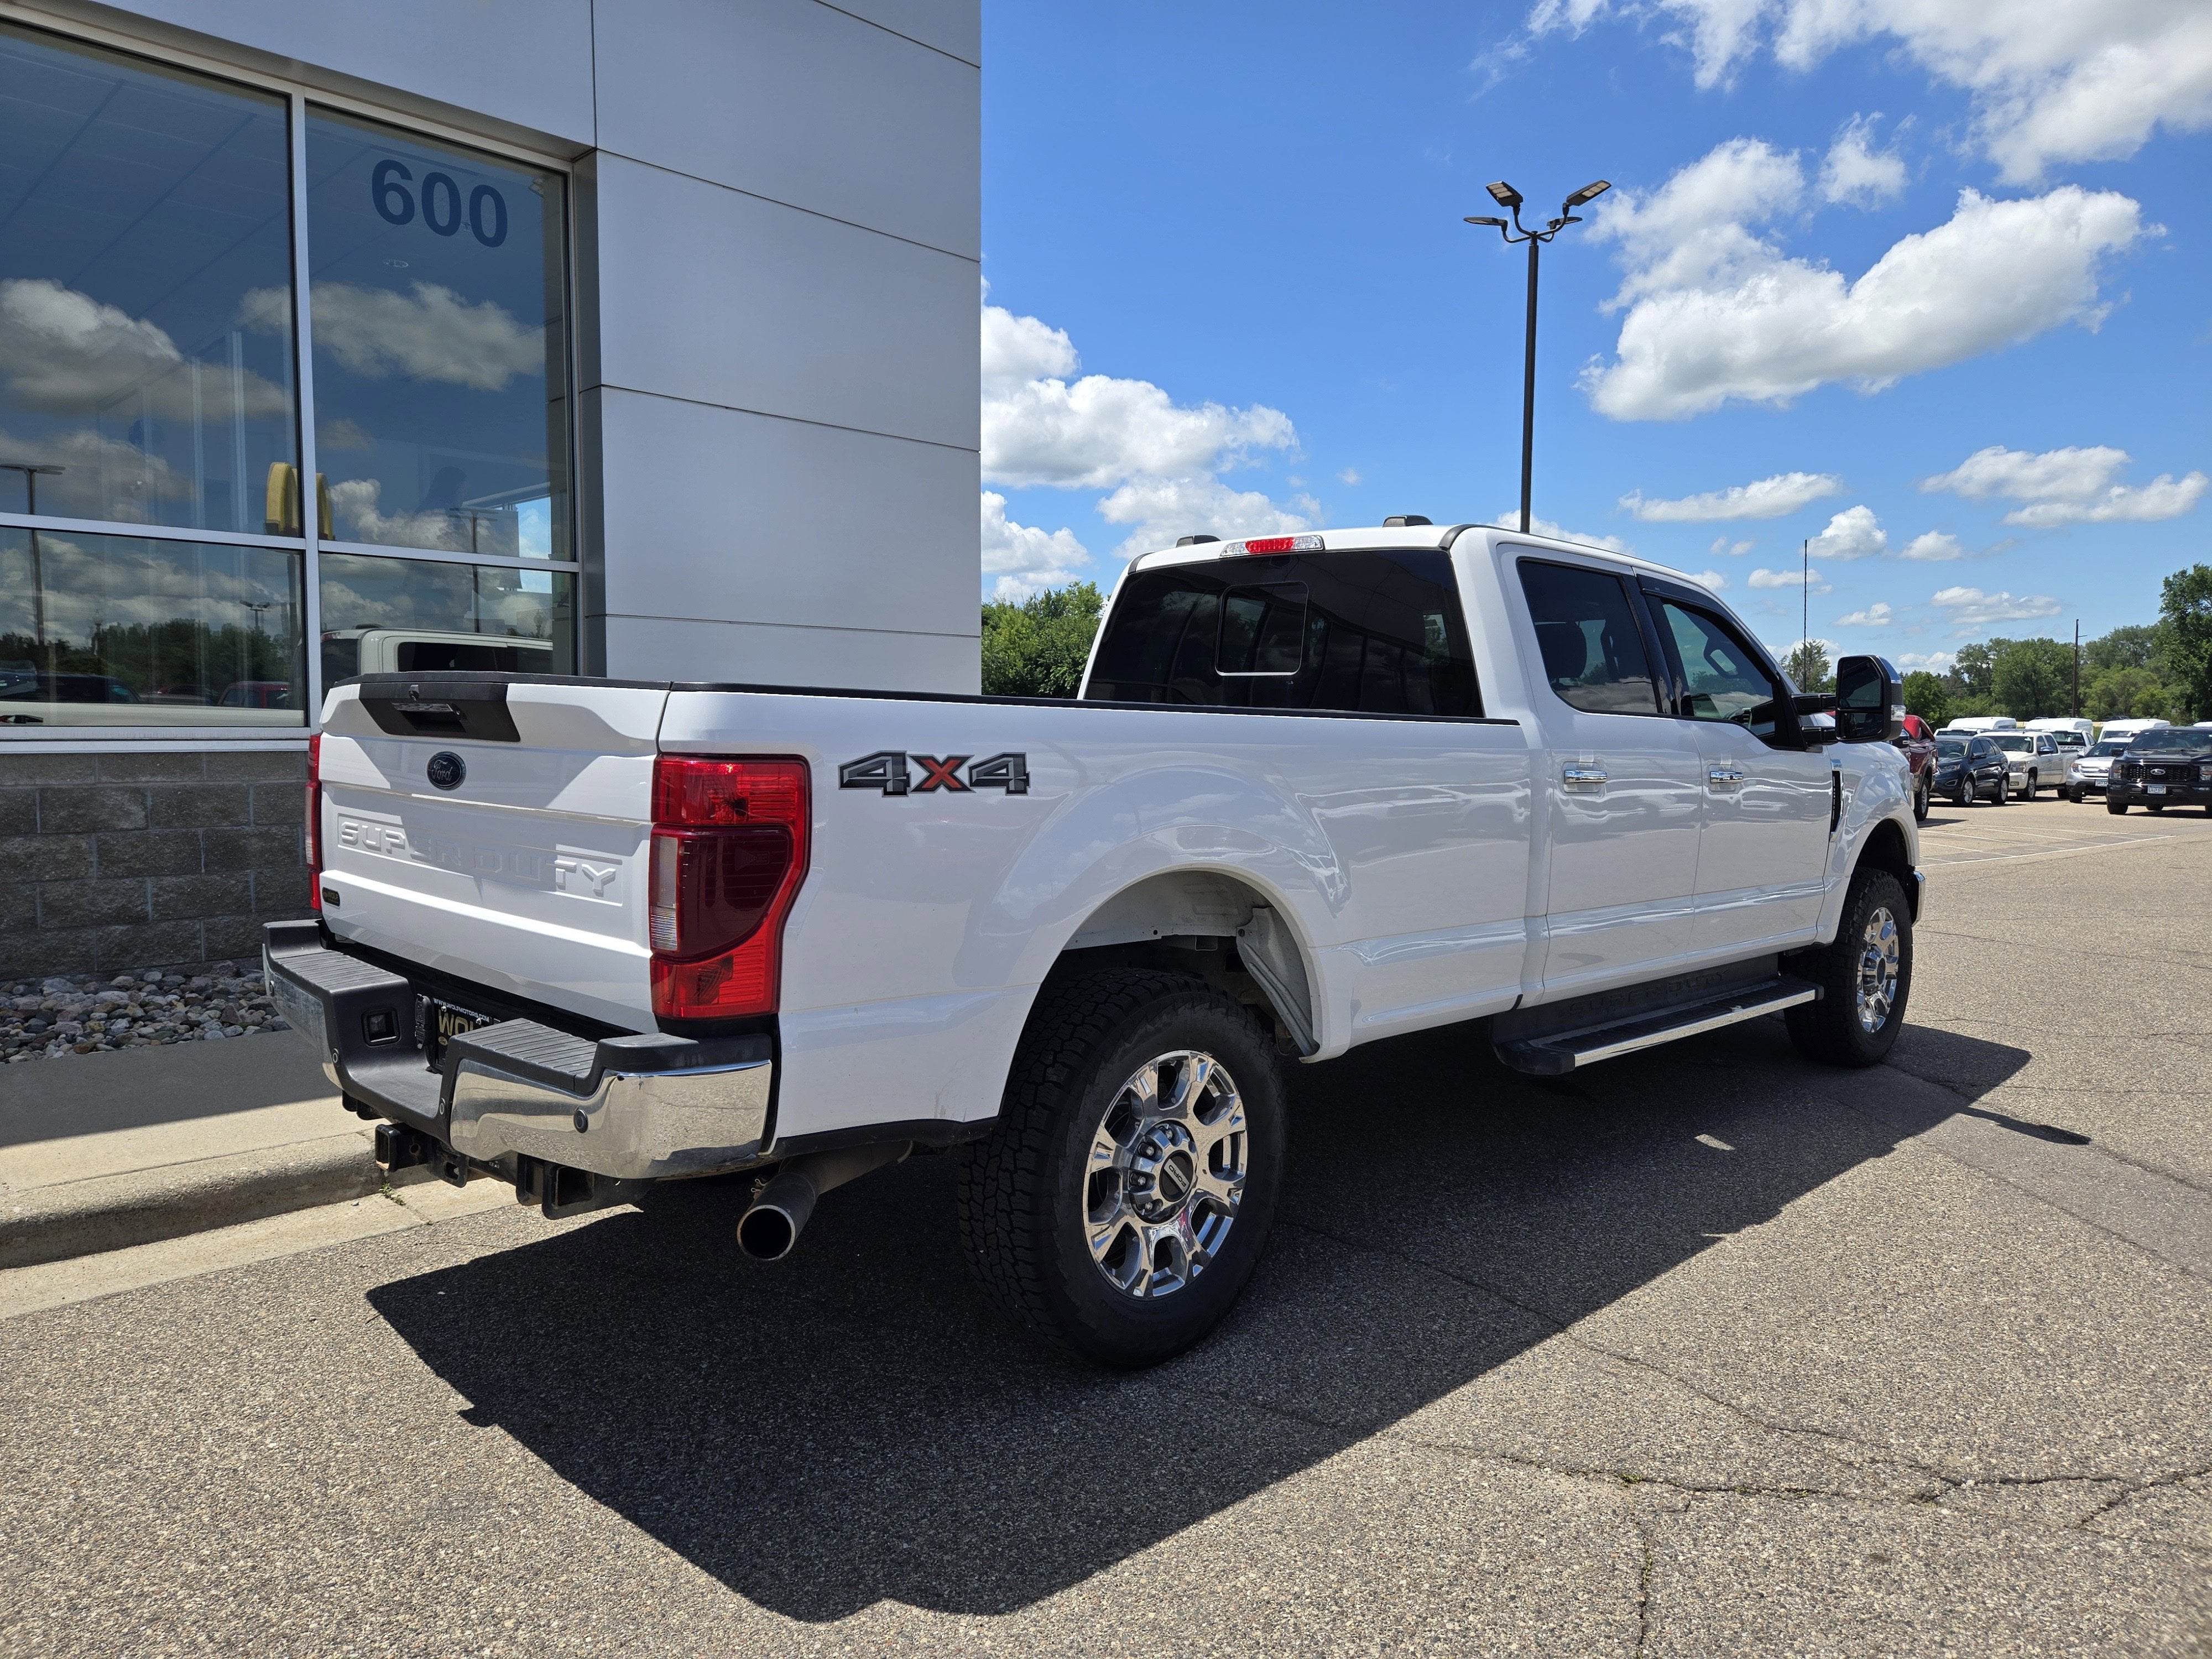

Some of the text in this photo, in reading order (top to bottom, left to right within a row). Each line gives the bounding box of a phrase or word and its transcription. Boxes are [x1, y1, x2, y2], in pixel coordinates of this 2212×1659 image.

[372, 159, 508, 248] 600
[431, 759, 453, 781] Ford
[838, 750, 1031, 797] 4X4
[341, 821, 616, 897] SUPER DUTY
[433, 998, 489, 1022] WWW.WOLFMOTORS.COM
[438, 1009, 485, 1036] WO
[1168, 1165, 1187, 1187] FORD
